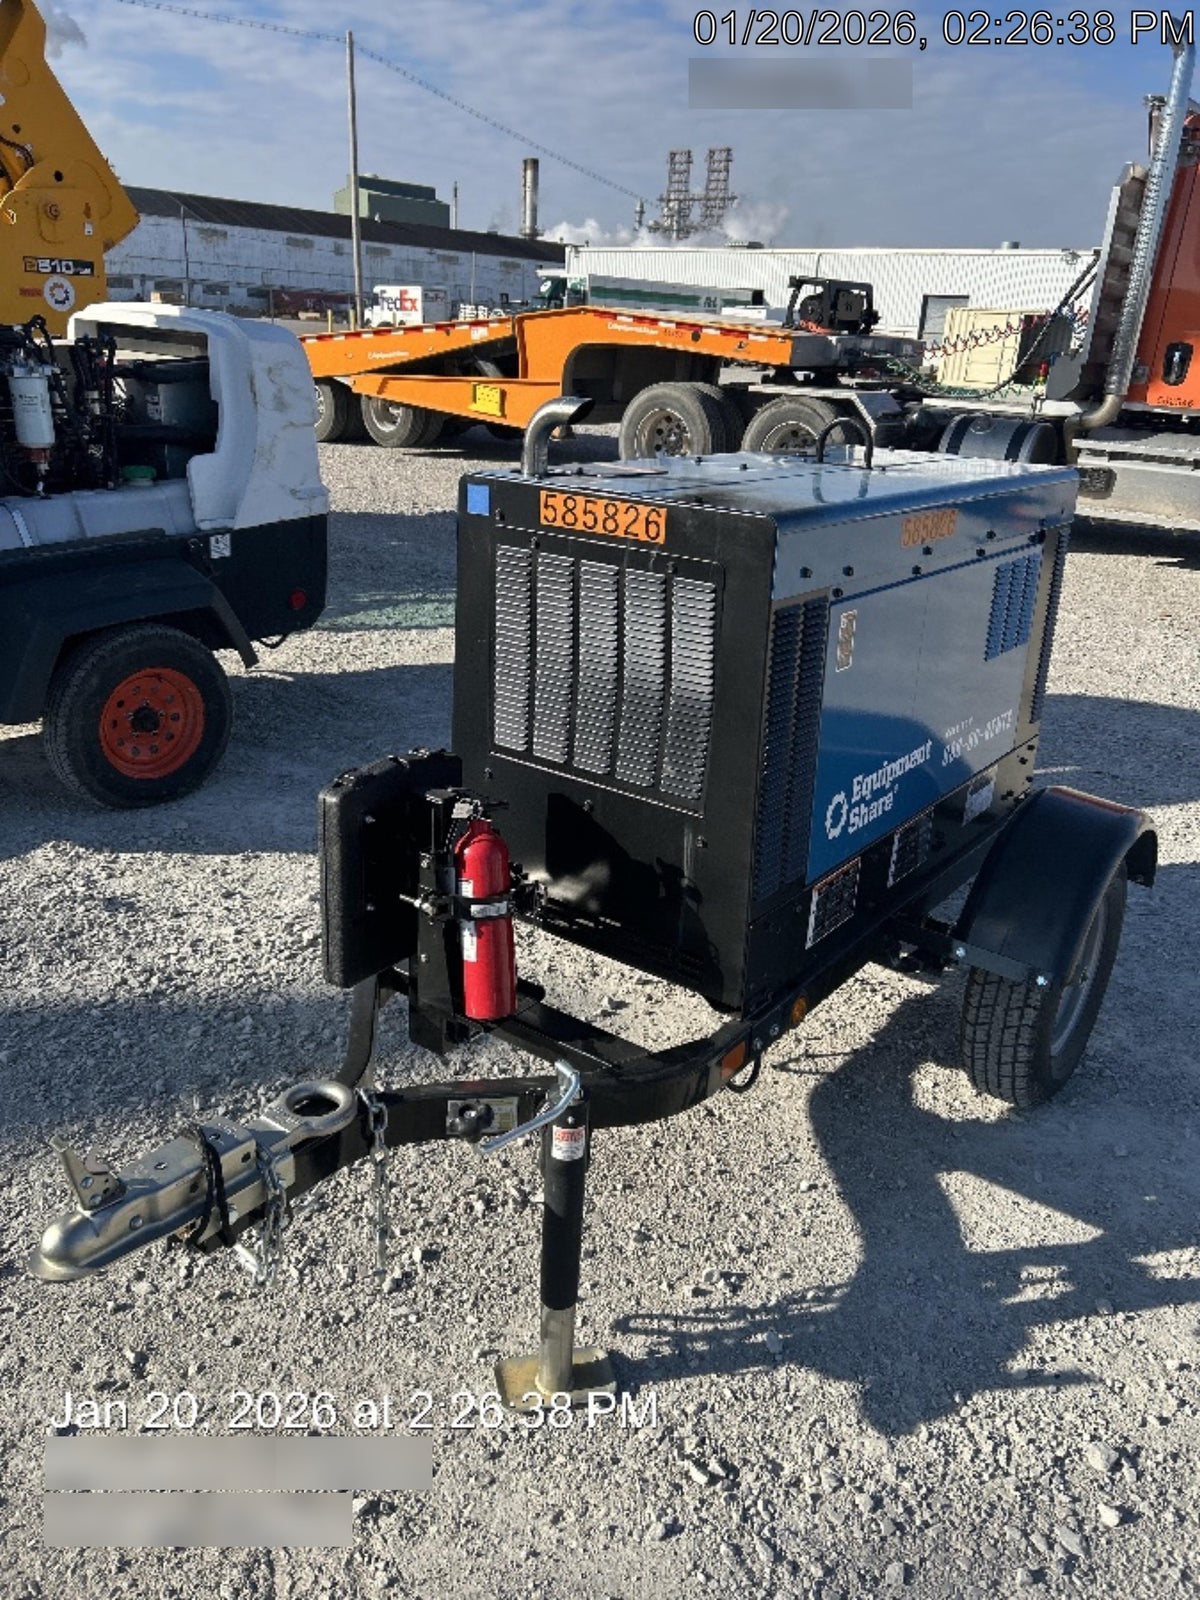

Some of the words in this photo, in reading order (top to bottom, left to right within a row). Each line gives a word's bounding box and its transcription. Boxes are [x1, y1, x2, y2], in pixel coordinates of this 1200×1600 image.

[379, 289, 418, 312] FedEx
[542, 493, 662, 543] 585826
[851, 740, 933, 804] Equipment
[847, 790, 894, 834] Share
